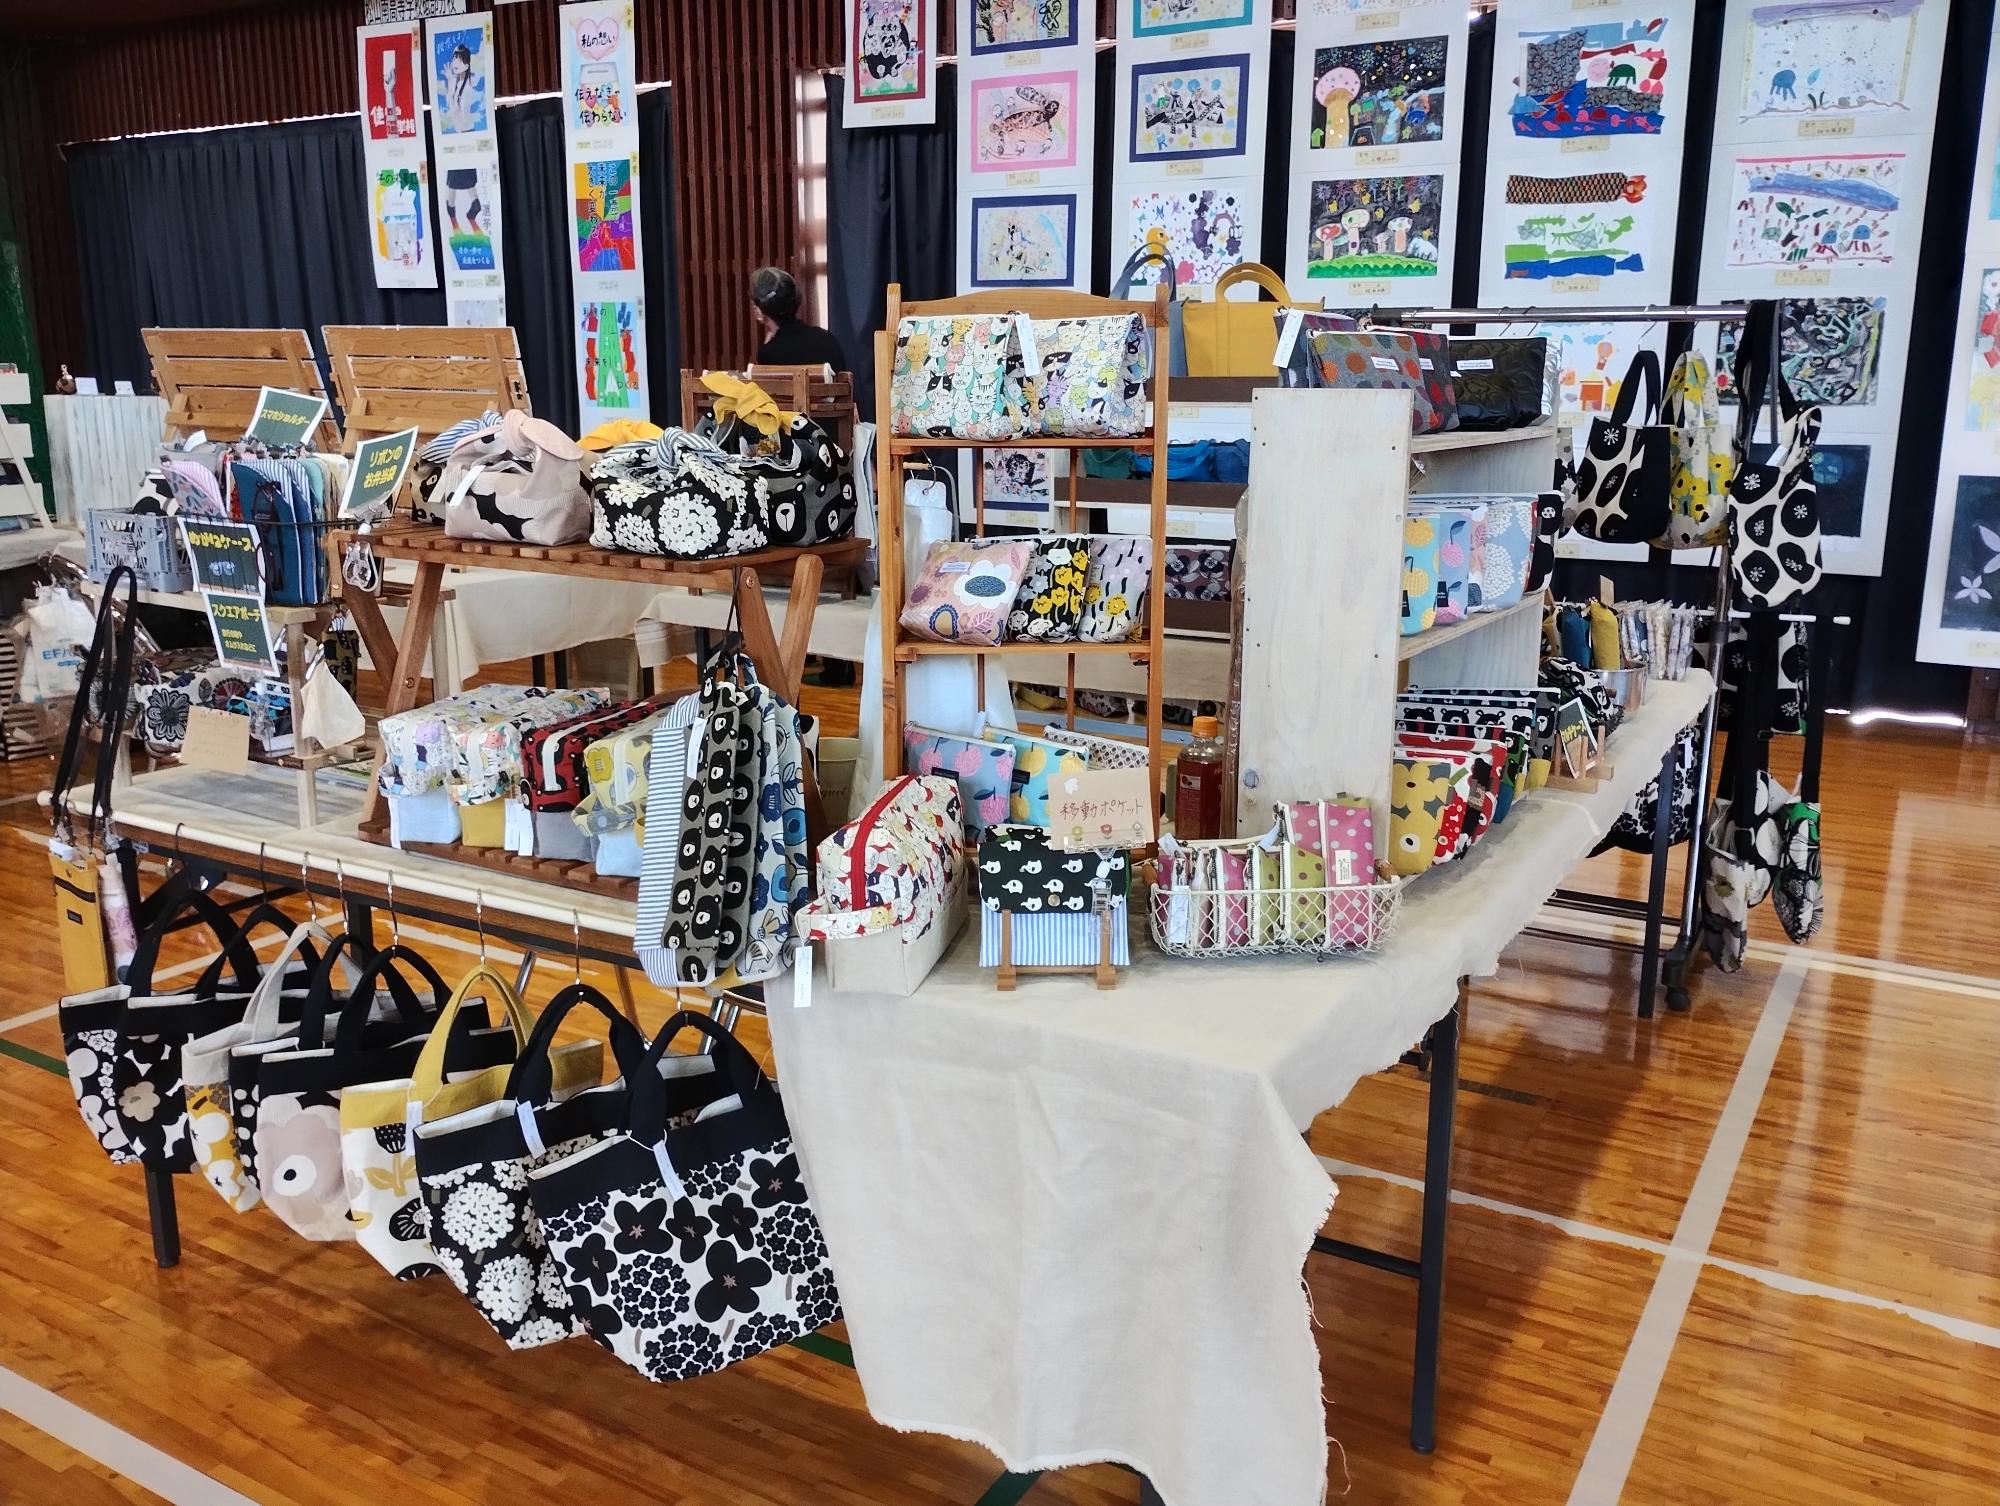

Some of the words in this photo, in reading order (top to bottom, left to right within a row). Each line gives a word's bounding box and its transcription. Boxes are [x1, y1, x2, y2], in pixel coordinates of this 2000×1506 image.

[581, 32, 616, 48] 私の想い
[579, 110, 627, 124] 伝わらない
[260, 408, 311, 426] スマホショルダー
[369, 445, 404, 468] リボンの
[363, 464, 399, 489] お弁当袋
[211, 603, 263, 622] スクエアポーチ
[1060, 798, 1143, 820] 移動ポケット
